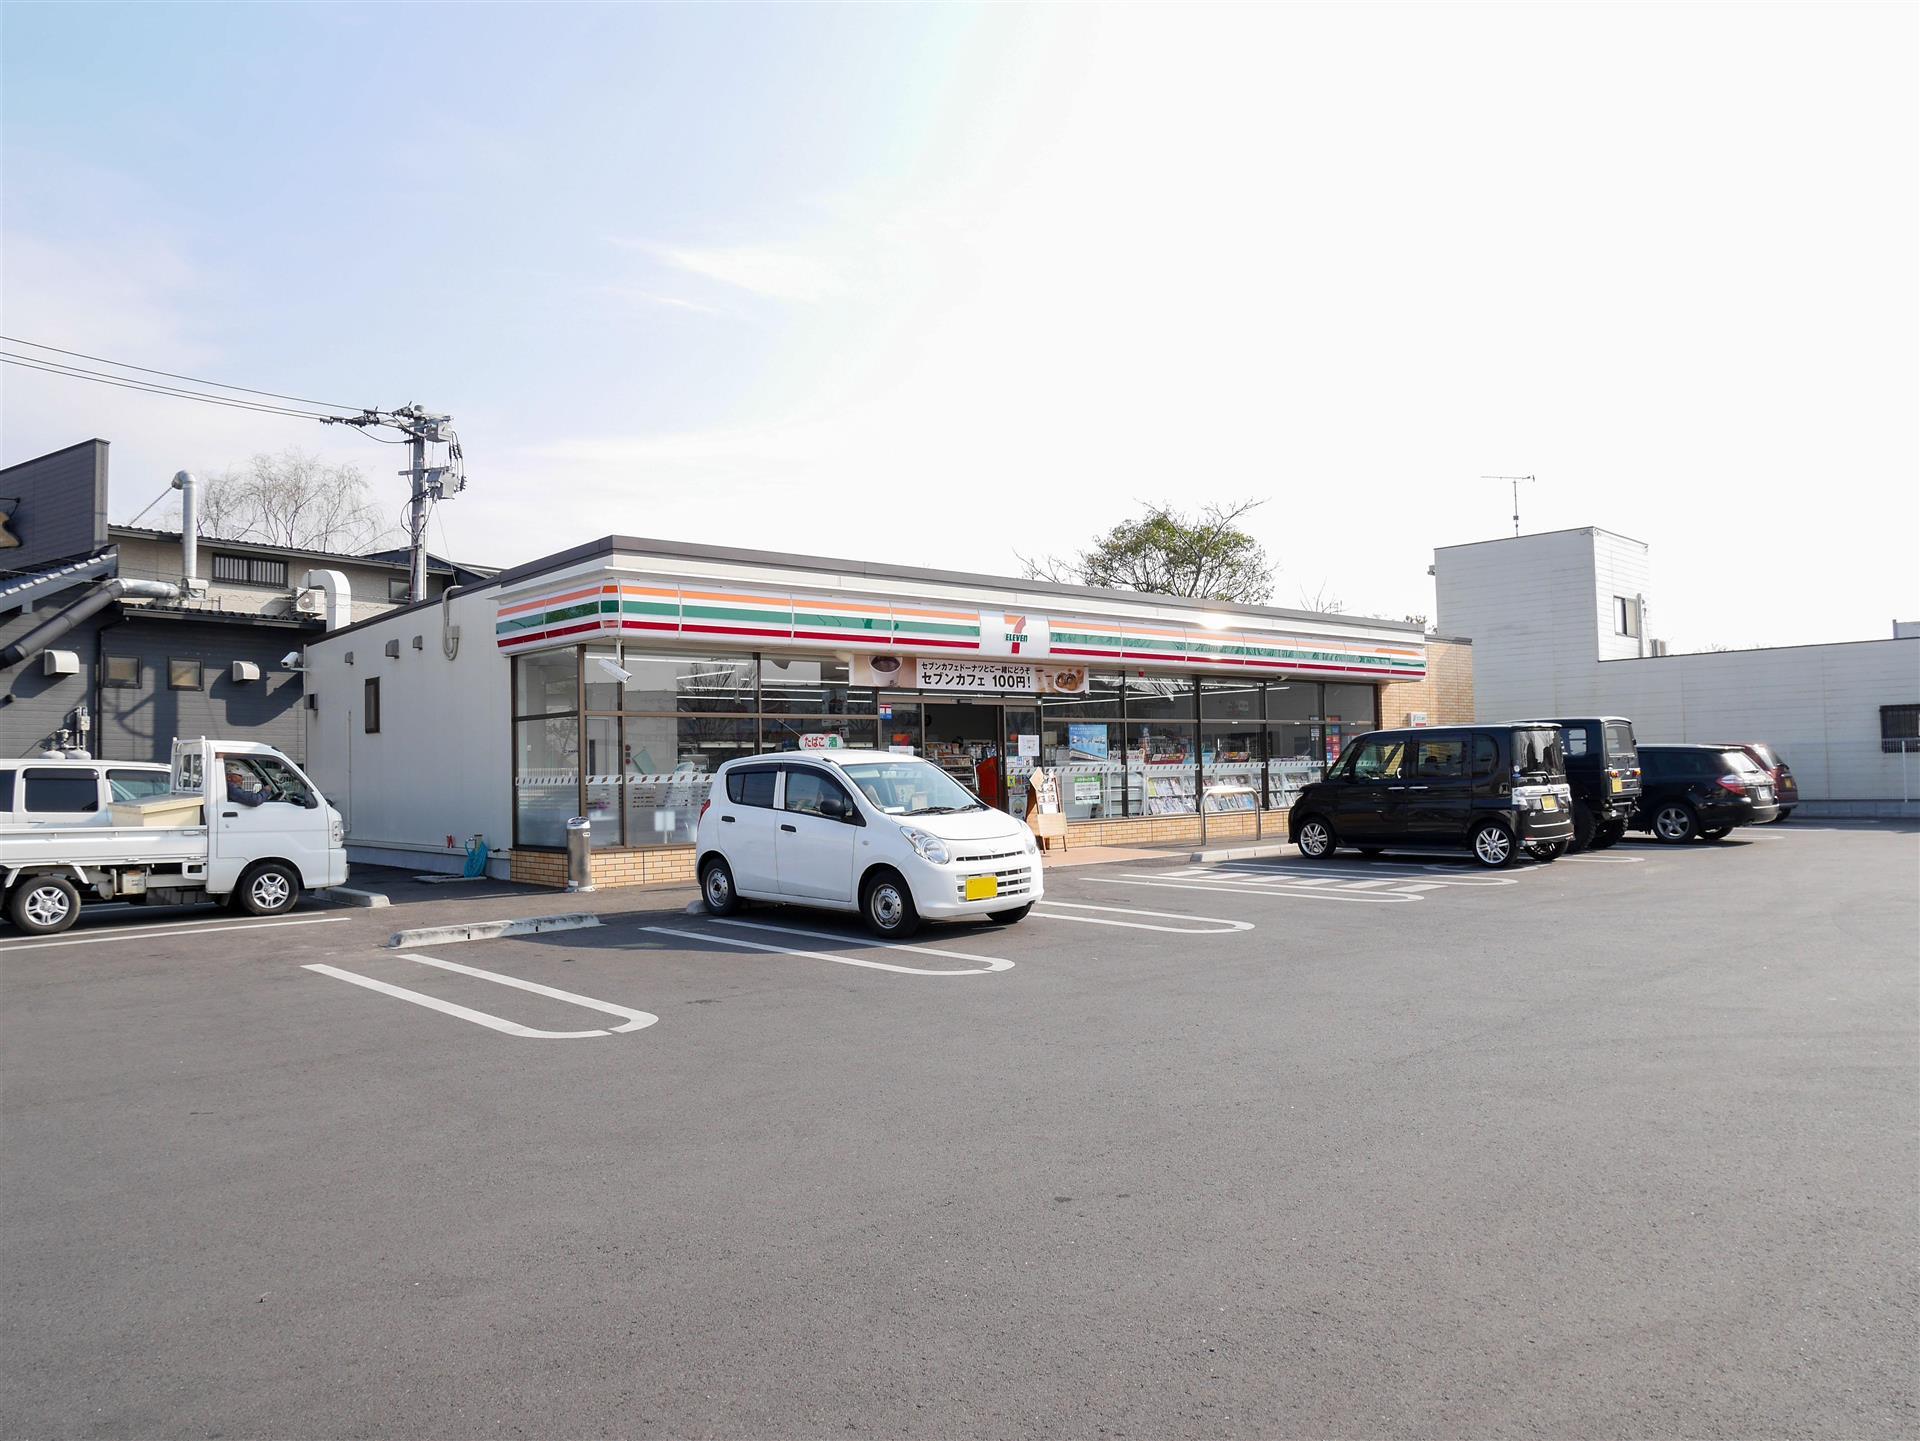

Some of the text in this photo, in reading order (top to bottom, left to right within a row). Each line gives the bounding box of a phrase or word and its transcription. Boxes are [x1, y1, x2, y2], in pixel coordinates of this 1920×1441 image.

[922, 672, 985, 686] セブンカフェ
[804, 736, 824, 747] たばこ
